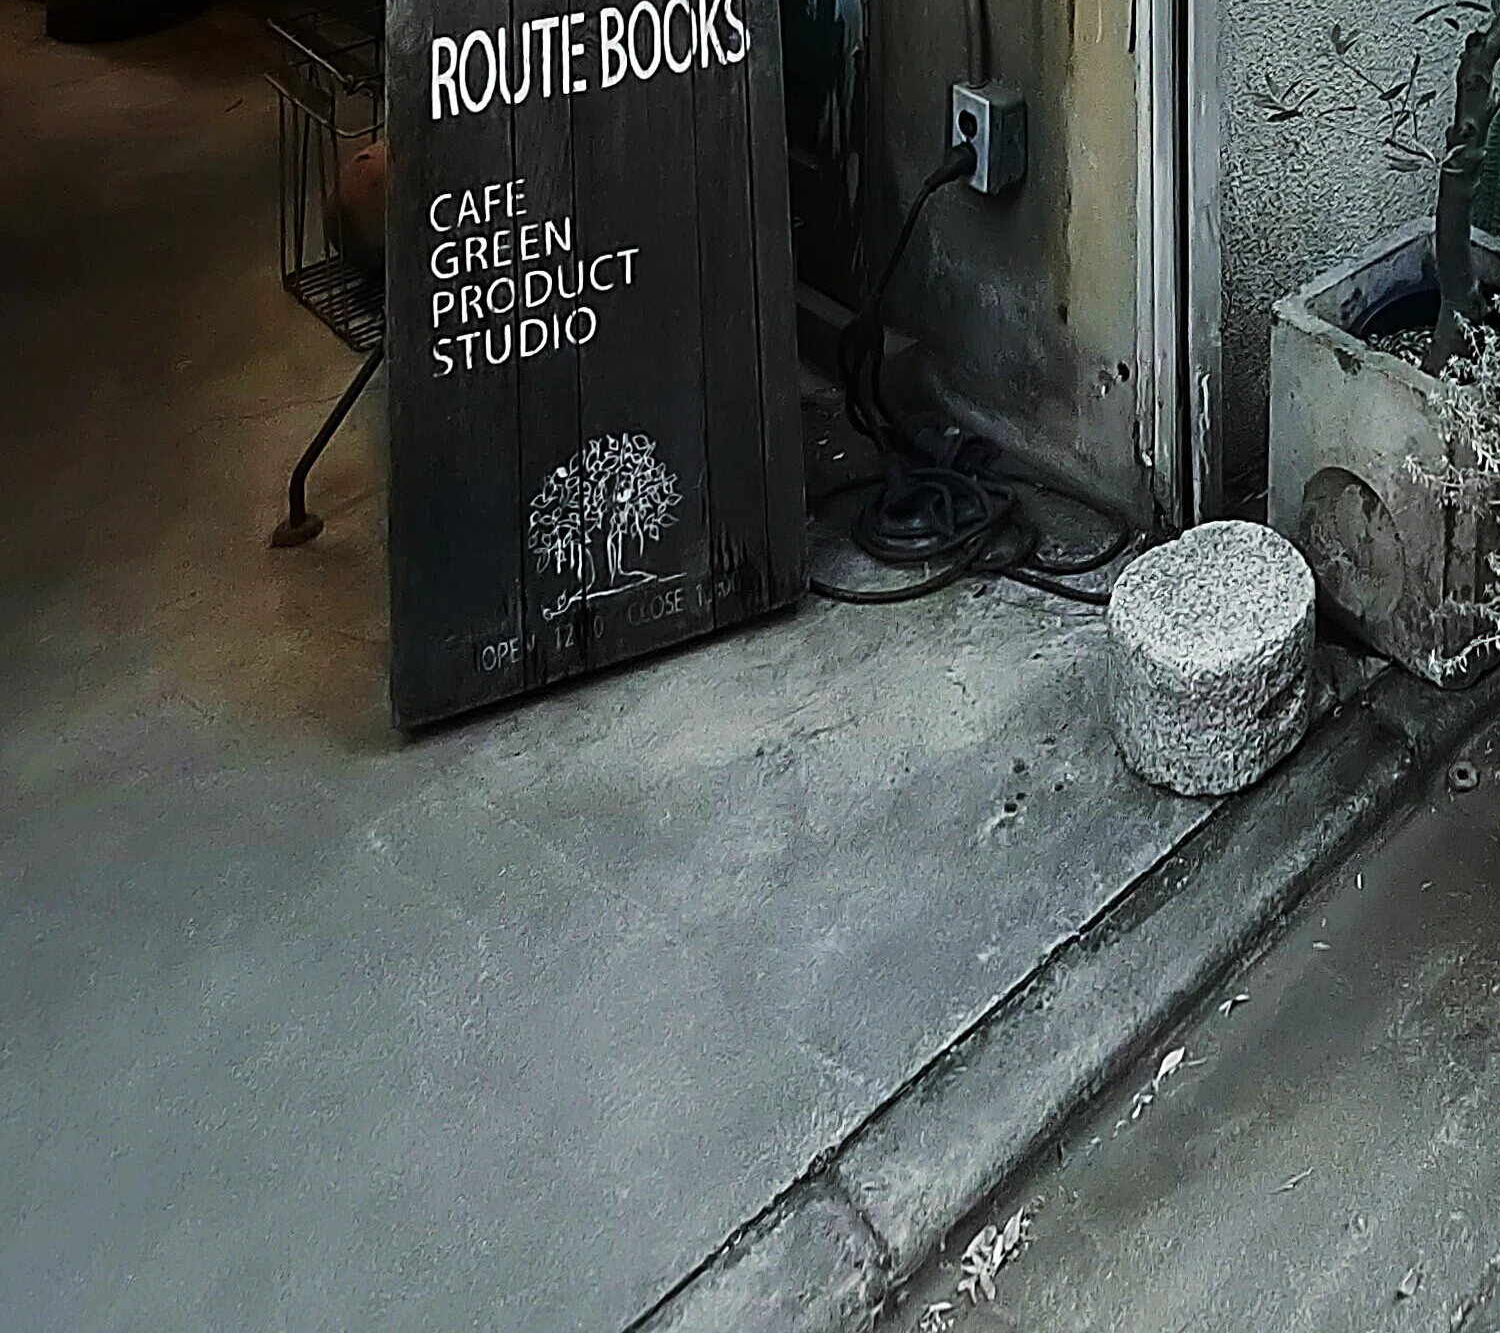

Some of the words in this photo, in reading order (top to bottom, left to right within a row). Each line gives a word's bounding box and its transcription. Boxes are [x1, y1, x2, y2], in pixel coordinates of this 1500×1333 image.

[430, 11, 588, 121] ROUTE
[429, 178, 527, 233] CAFE
[430, 216, 572, 280] GREEN
[432, 247, 640, 329] PRODUCT
[432, 306, 598, 378] STUDIO
